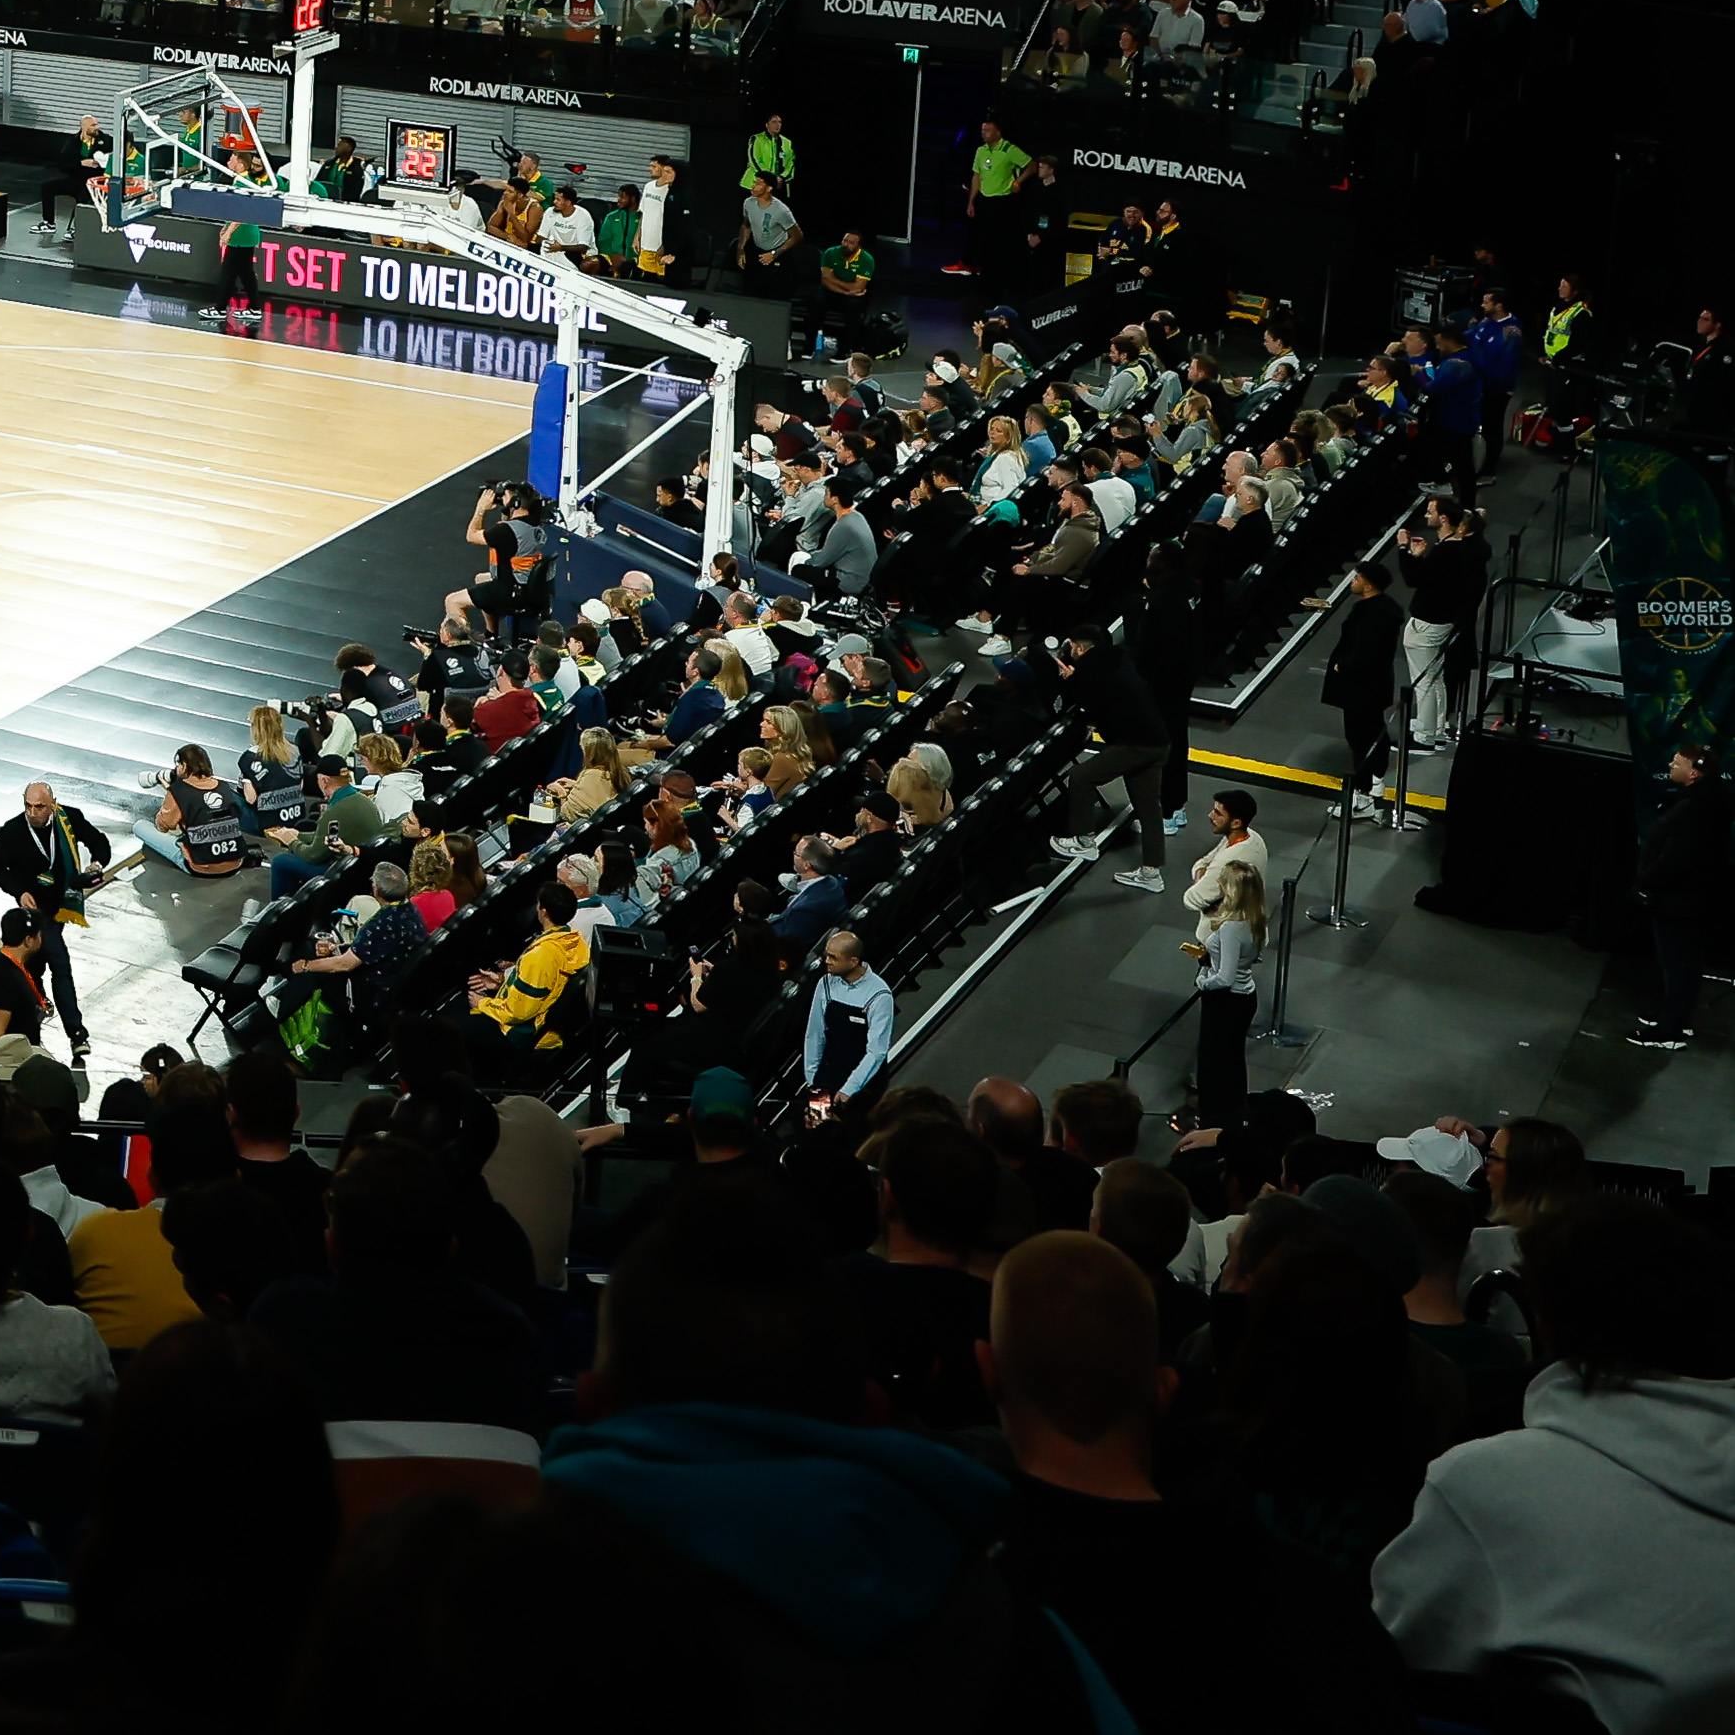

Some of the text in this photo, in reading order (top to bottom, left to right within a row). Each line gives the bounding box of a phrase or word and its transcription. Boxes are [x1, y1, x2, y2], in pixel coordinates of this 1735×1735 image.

[406, 128, 445, 152] 6:25
[402, 150, 438, 178] 22
[468, 240, 557, 288] GARED
[285, 245, 347, 292] SET
[361, 255, 401, 303] TO
[408, 263, 608, 333] MELBOURE
[1636, 598, 1733, 616] BOOMERS
[1661, 613, 1734, 633] WORLD
[210, 831, 238, 856] 082
